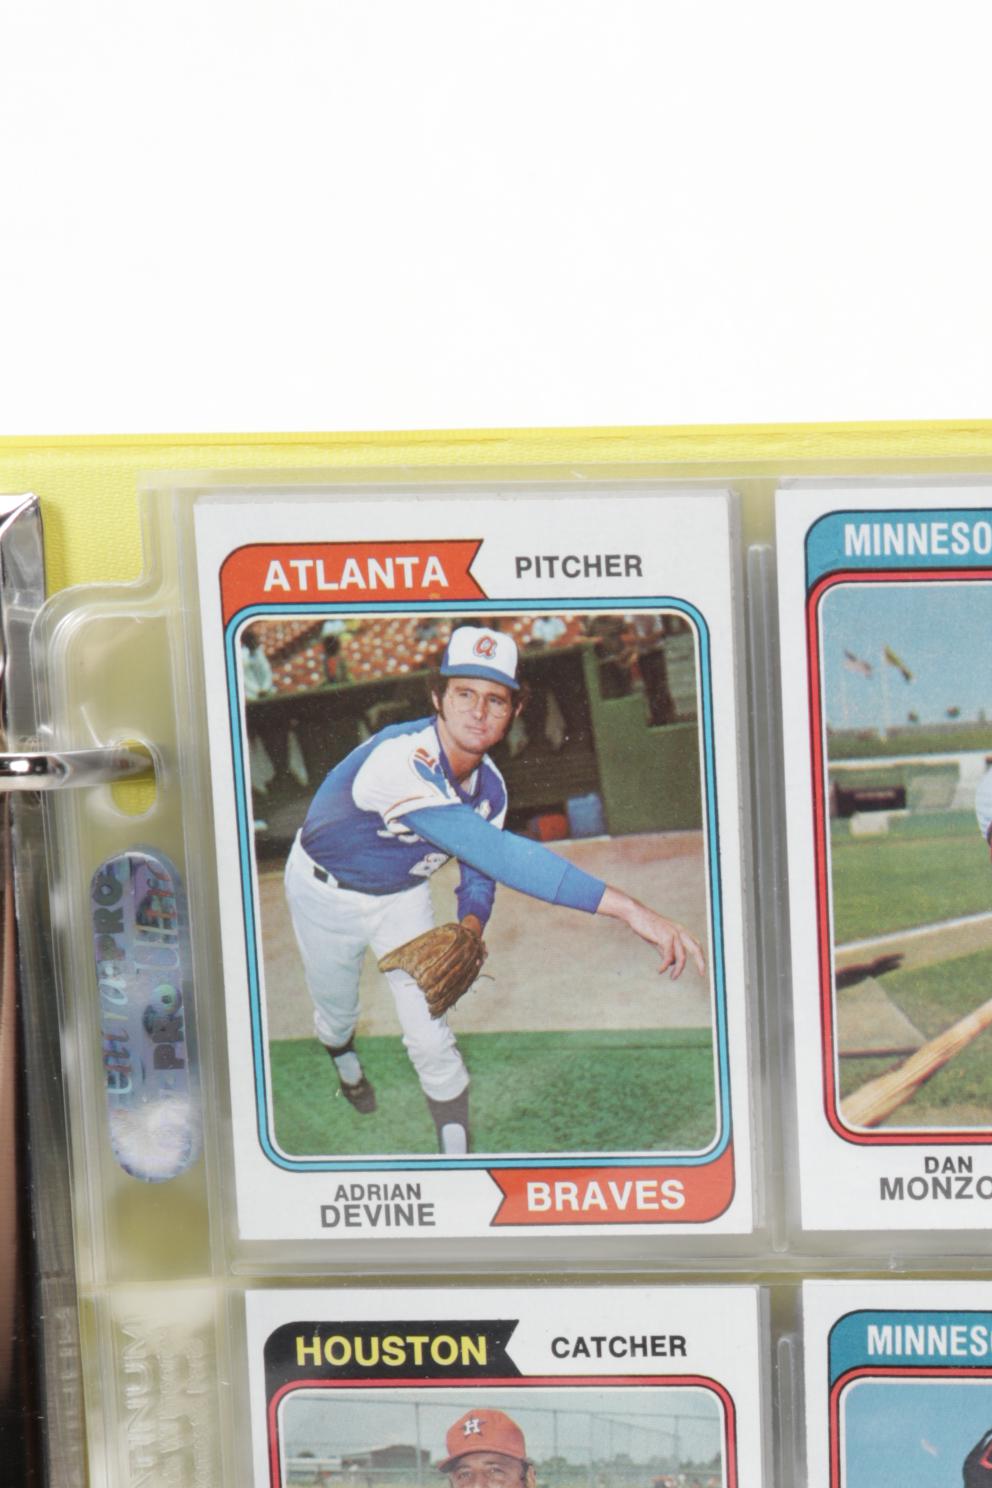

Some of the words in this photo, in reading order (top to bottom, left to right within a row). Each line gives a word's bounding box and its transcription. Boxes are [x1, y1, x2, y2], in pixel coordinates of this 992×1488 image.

[263, 555, 449, 592] ATLANTA
[515, 554, 643, 579] PITCHER
[924, 1155, 973, 1174] DAN
[334, 1183, 422, 1202] ADRIAN
[527, 1179, 686, 1212] BRAVES
[320, 1202, 436, 1229] DEVINE
[295, 1334, 488, 1367] HOUSTON
[550, 1334, 687, 1359] CATCHER
[463, 1418, 482, 1436] H
